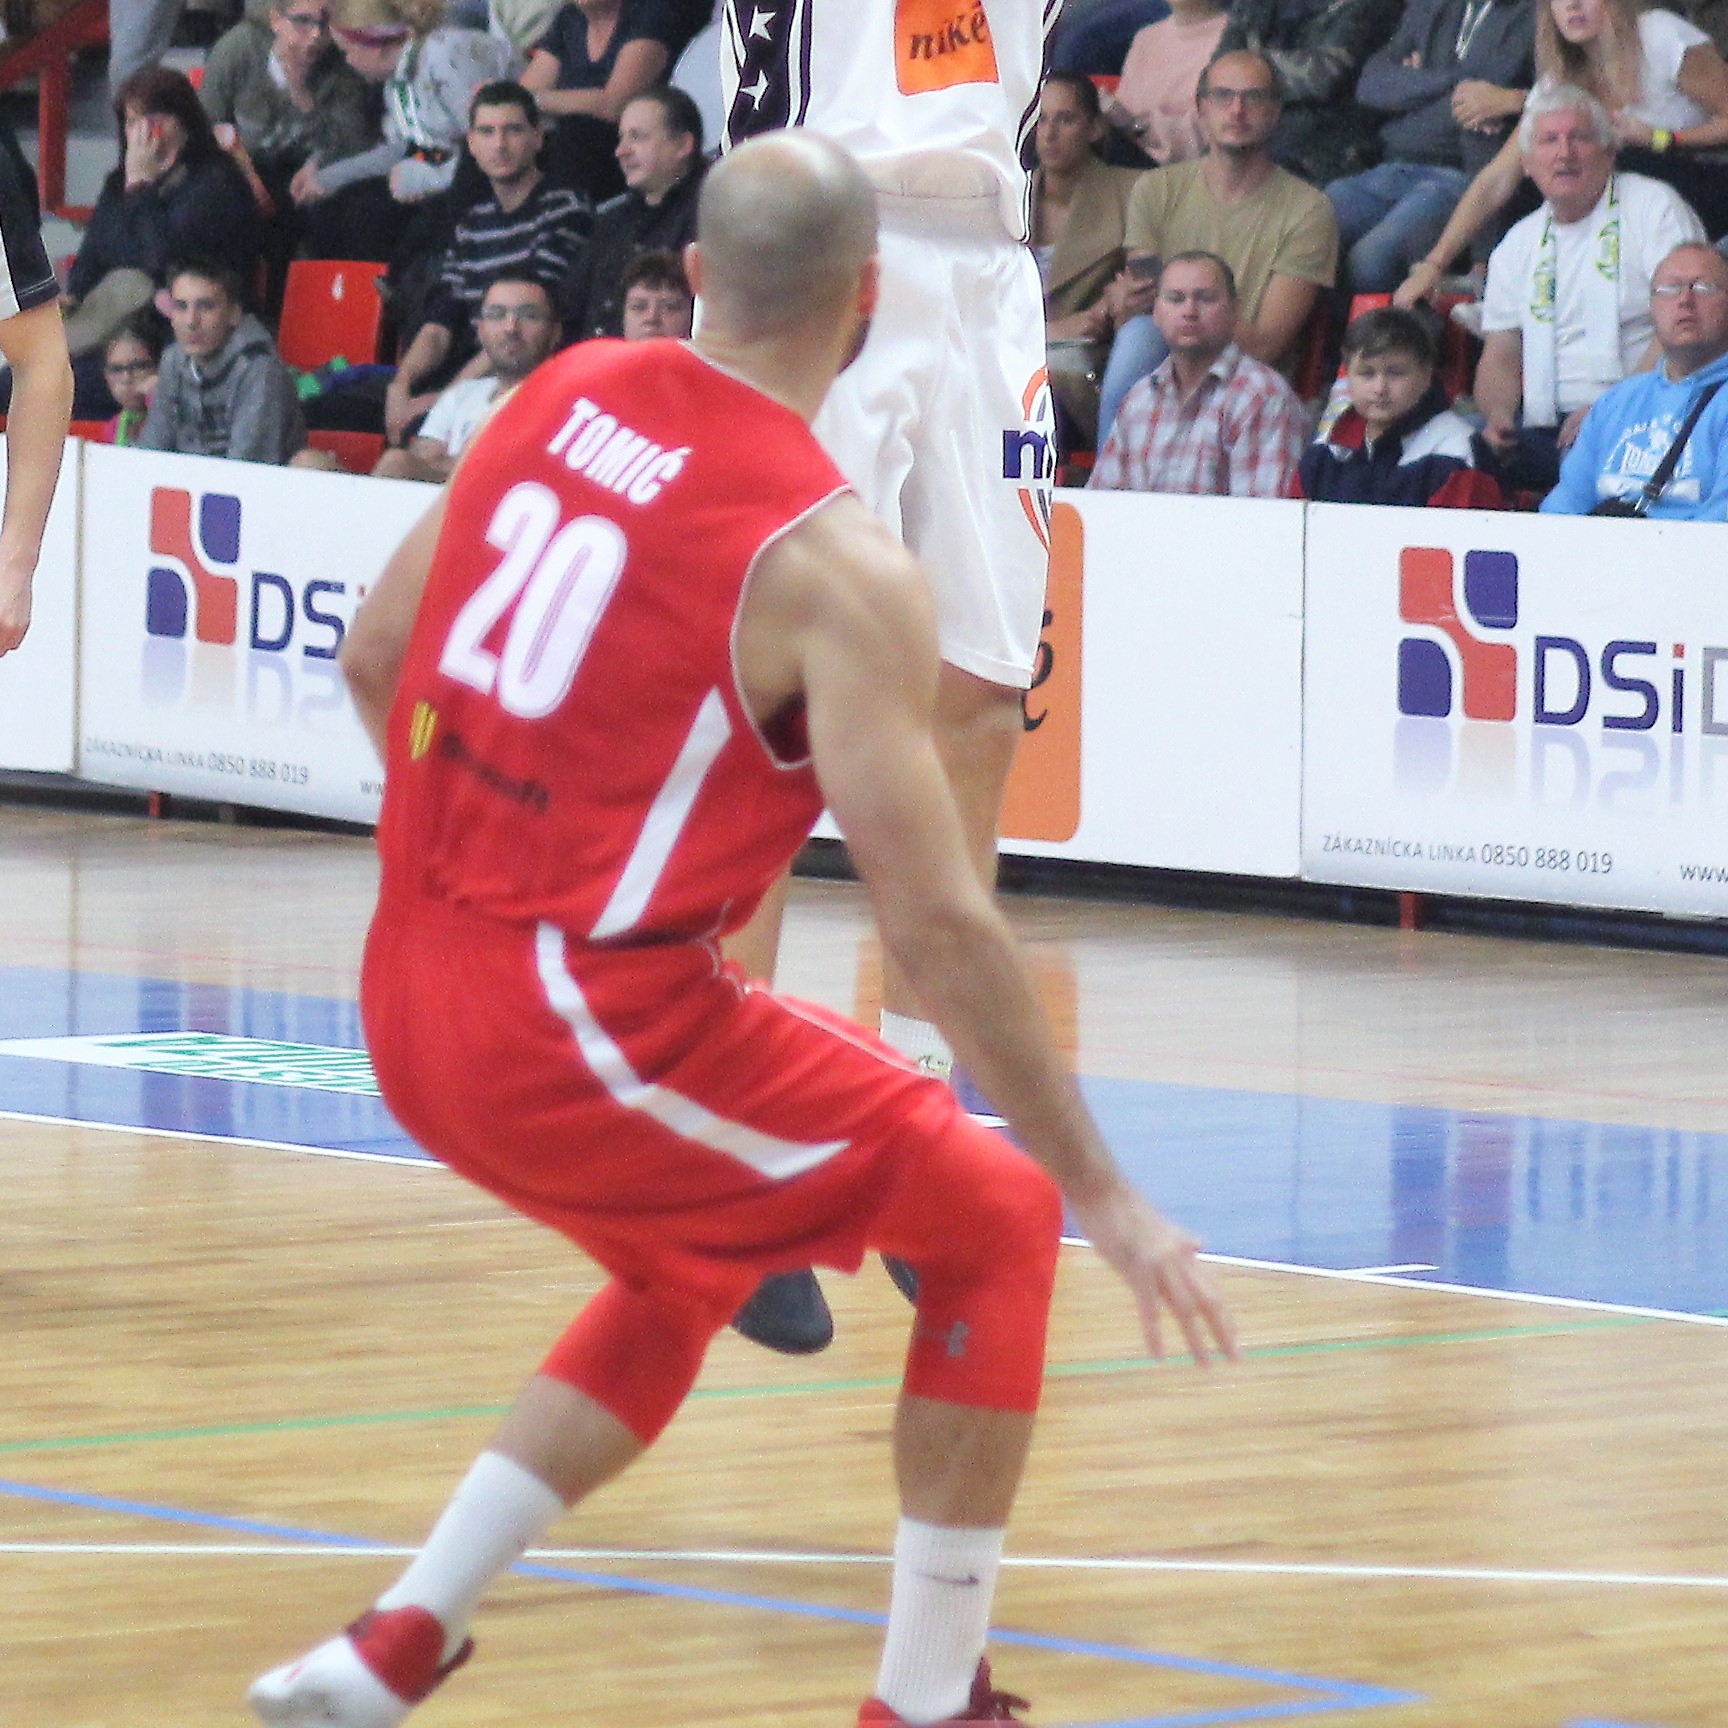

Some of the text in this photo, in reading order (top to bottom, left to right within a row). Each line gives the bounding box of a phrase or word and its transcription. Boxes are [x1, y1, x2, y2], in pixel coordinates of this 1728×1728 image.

[546, 396, 693, 506] TOMIĆ
[248, 570, 366, 660] DS
[437, 480, 629, 720] 20
[1429, 843, 1477, 865] LINKA
[1480, 842, 1529, 869] 0850
[1535, 847, 1572, 873] 888
[1577, 850, 1614, 875] 019
